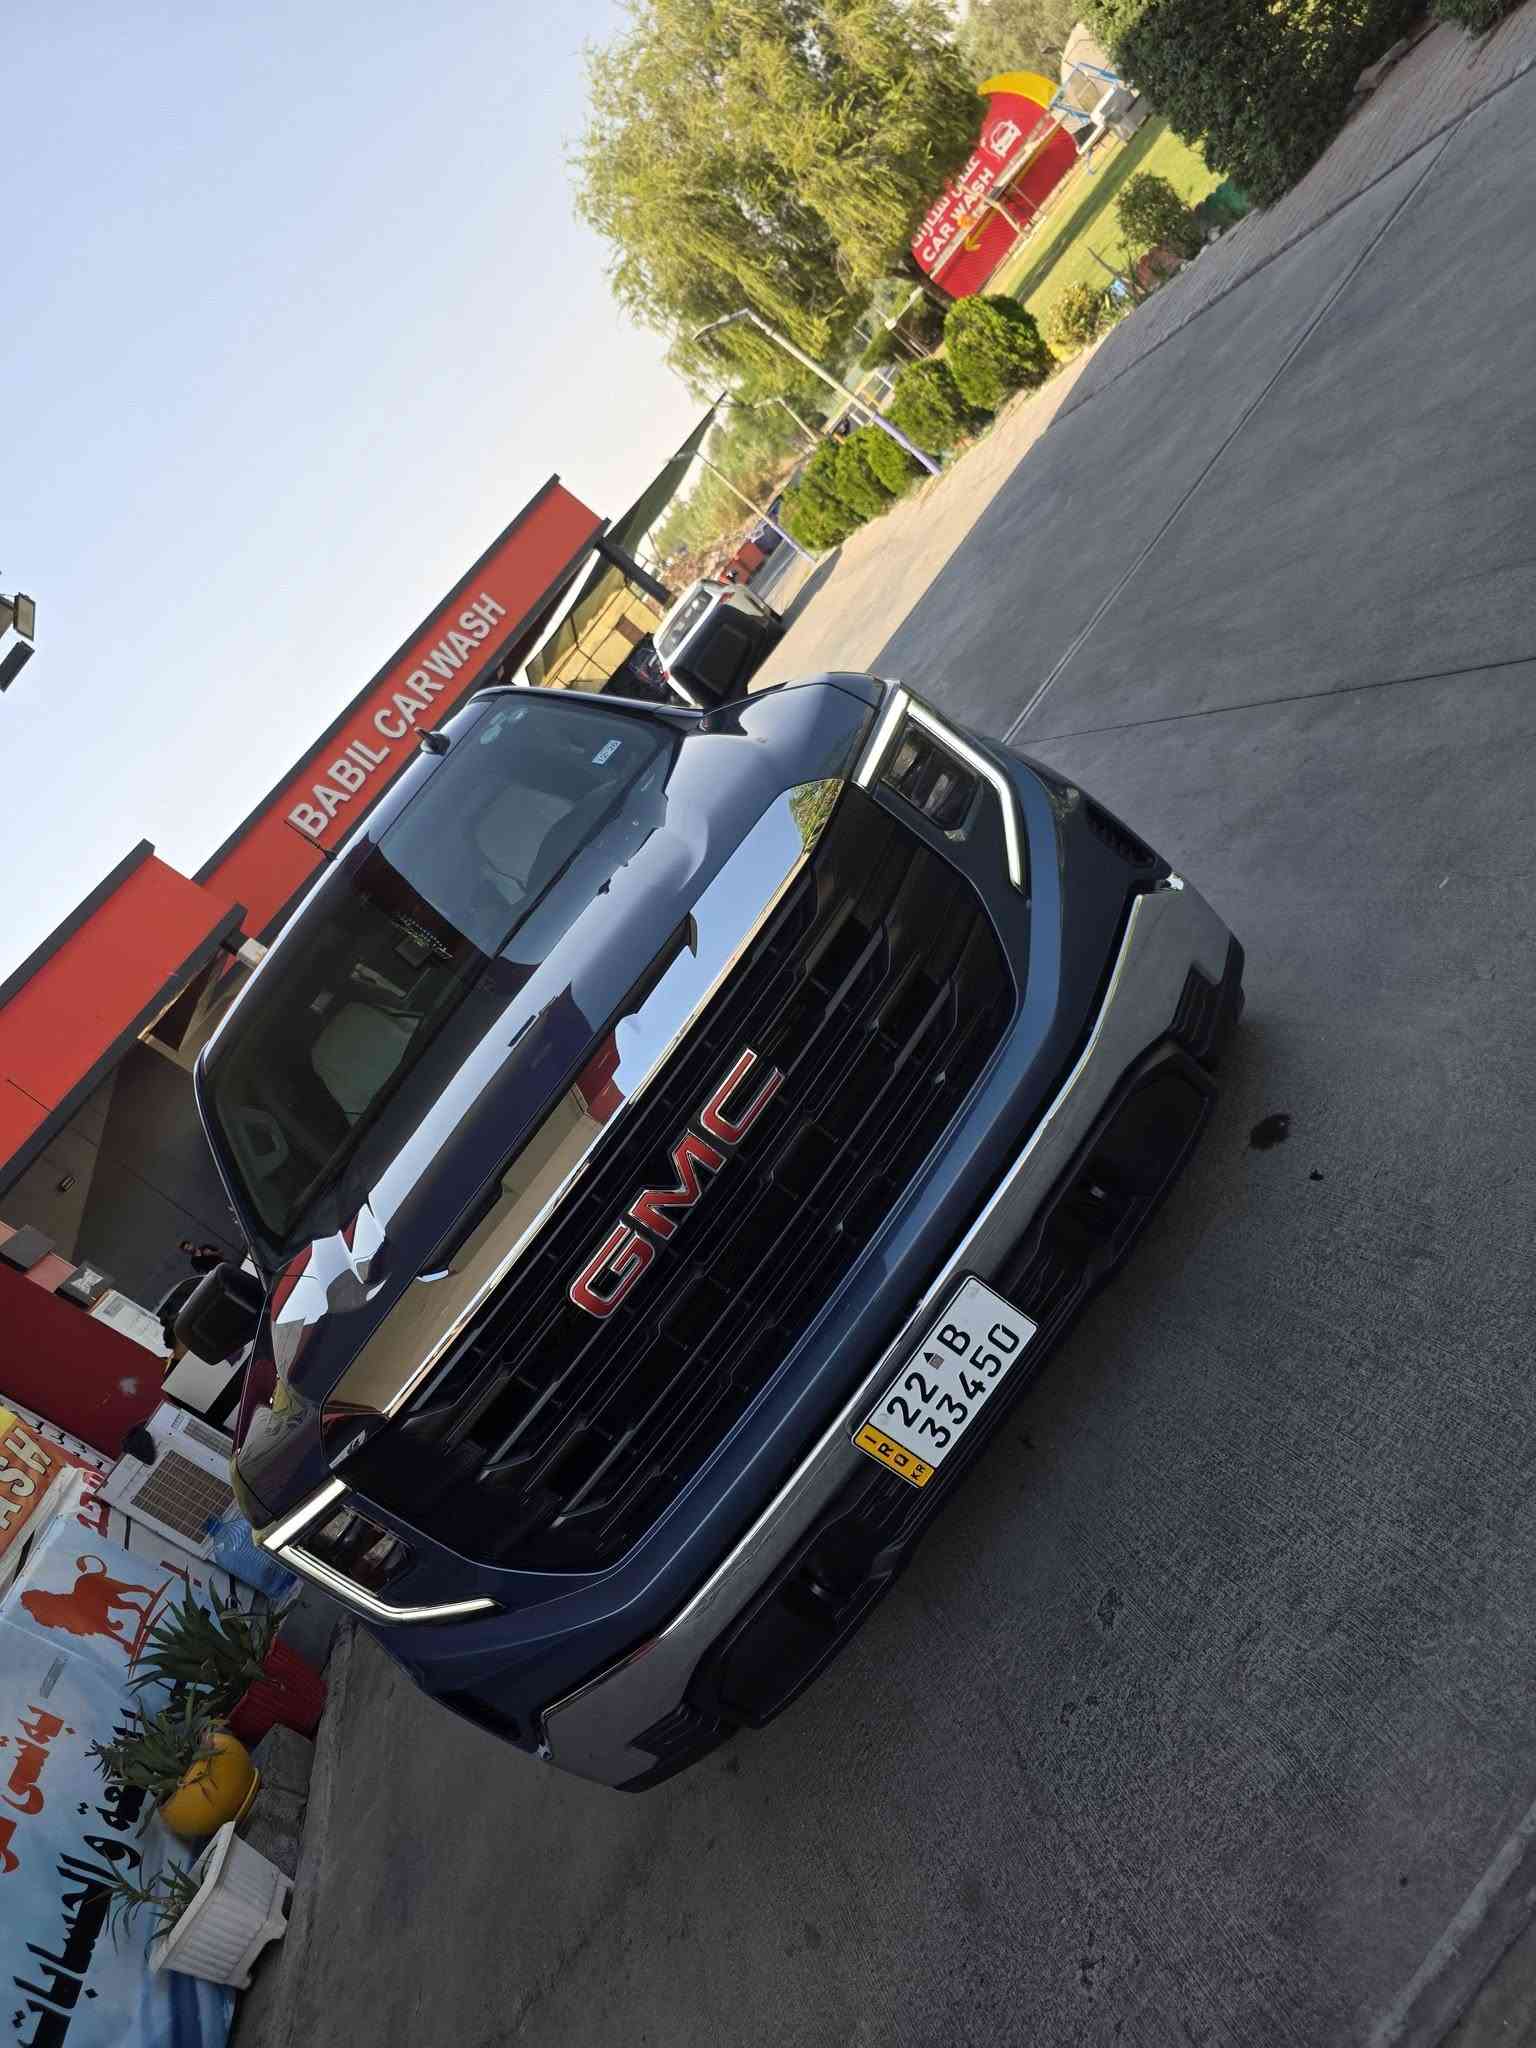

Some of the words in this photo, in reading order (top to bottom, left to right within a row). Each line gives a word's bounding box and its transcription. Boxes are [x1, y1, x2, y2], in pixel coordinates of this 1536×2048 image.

[922, 223, 956, 262] CAR
[949, 167, 995, 219] WASH
[287, 739, 391, 839] BABIL
[569, 1047, 786, 1319] GMC
[886, 1372, 939, 1428] 22
[936, 1323, 971, 1356] B
[918, 1323, 1020, 1449] 33450
[910, 1463, 926, 1480] KR
